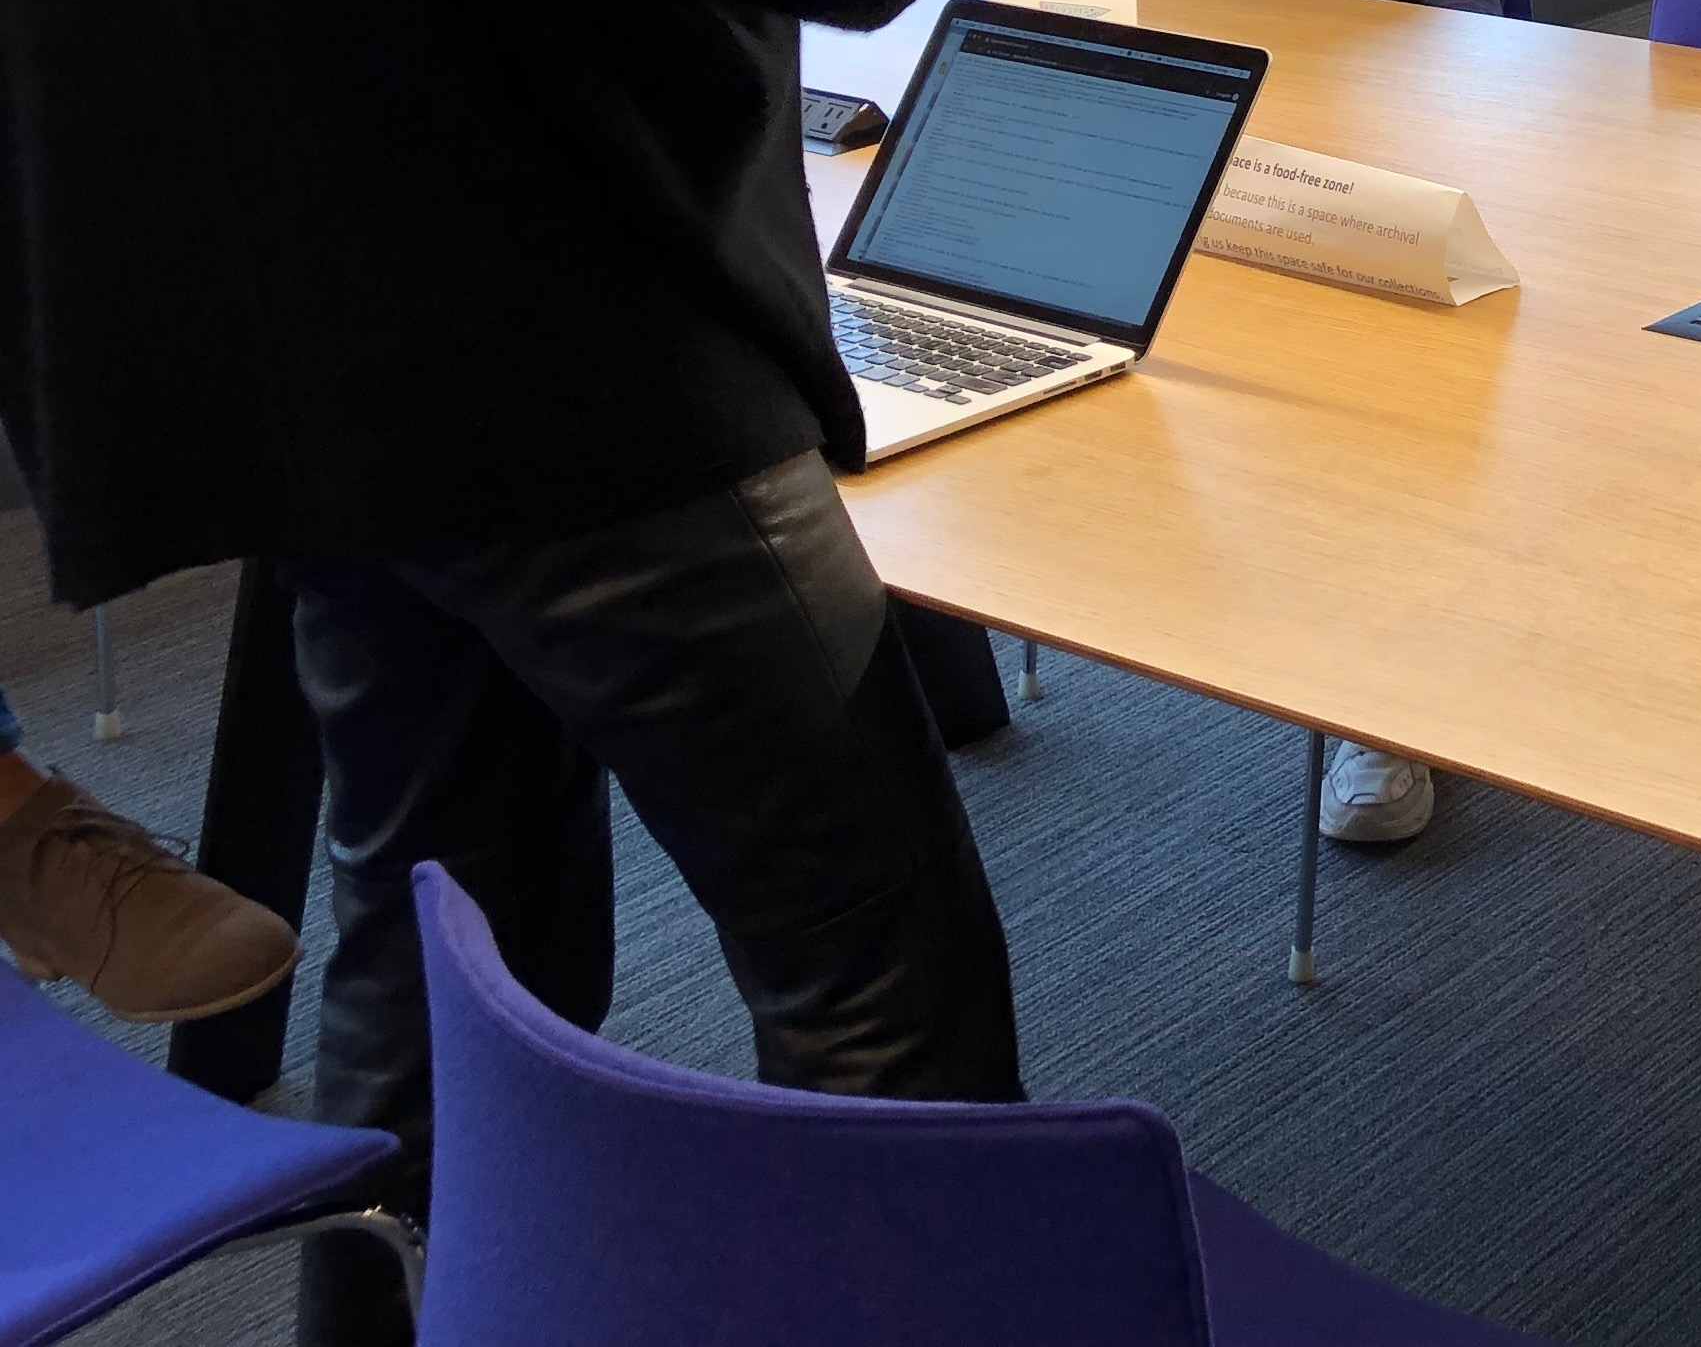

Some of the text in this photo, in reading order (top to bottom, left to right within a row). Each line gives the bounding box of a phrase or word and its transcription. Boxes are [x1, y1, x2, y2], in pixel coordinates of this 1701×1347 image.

[1231, 156, 1355, 195] ace is a food-free zone!
[1223, 184, 1266, 207] because
[1267, 195, 1286, 211] this
[1288, 199, 1296, 213] is
[1298, 206, 1305, 216] a
[1307, 206, 1338, 225] space
[1340, 214, 1375, 234] where
[1376, 224, 1420, 246] archival
[1265, 224, 1284, 238] are
[1286, 230, 1315, 246] used.
[1212, 239, 1224, 250] us
[1226, 239, 1253, 257] keep
[1254, 246, 1275, 261] this
[1276, 254, 1309, 270] space
[1356, 272, 1376, 285] our
[1378, 278, 1445, 301] collections.
